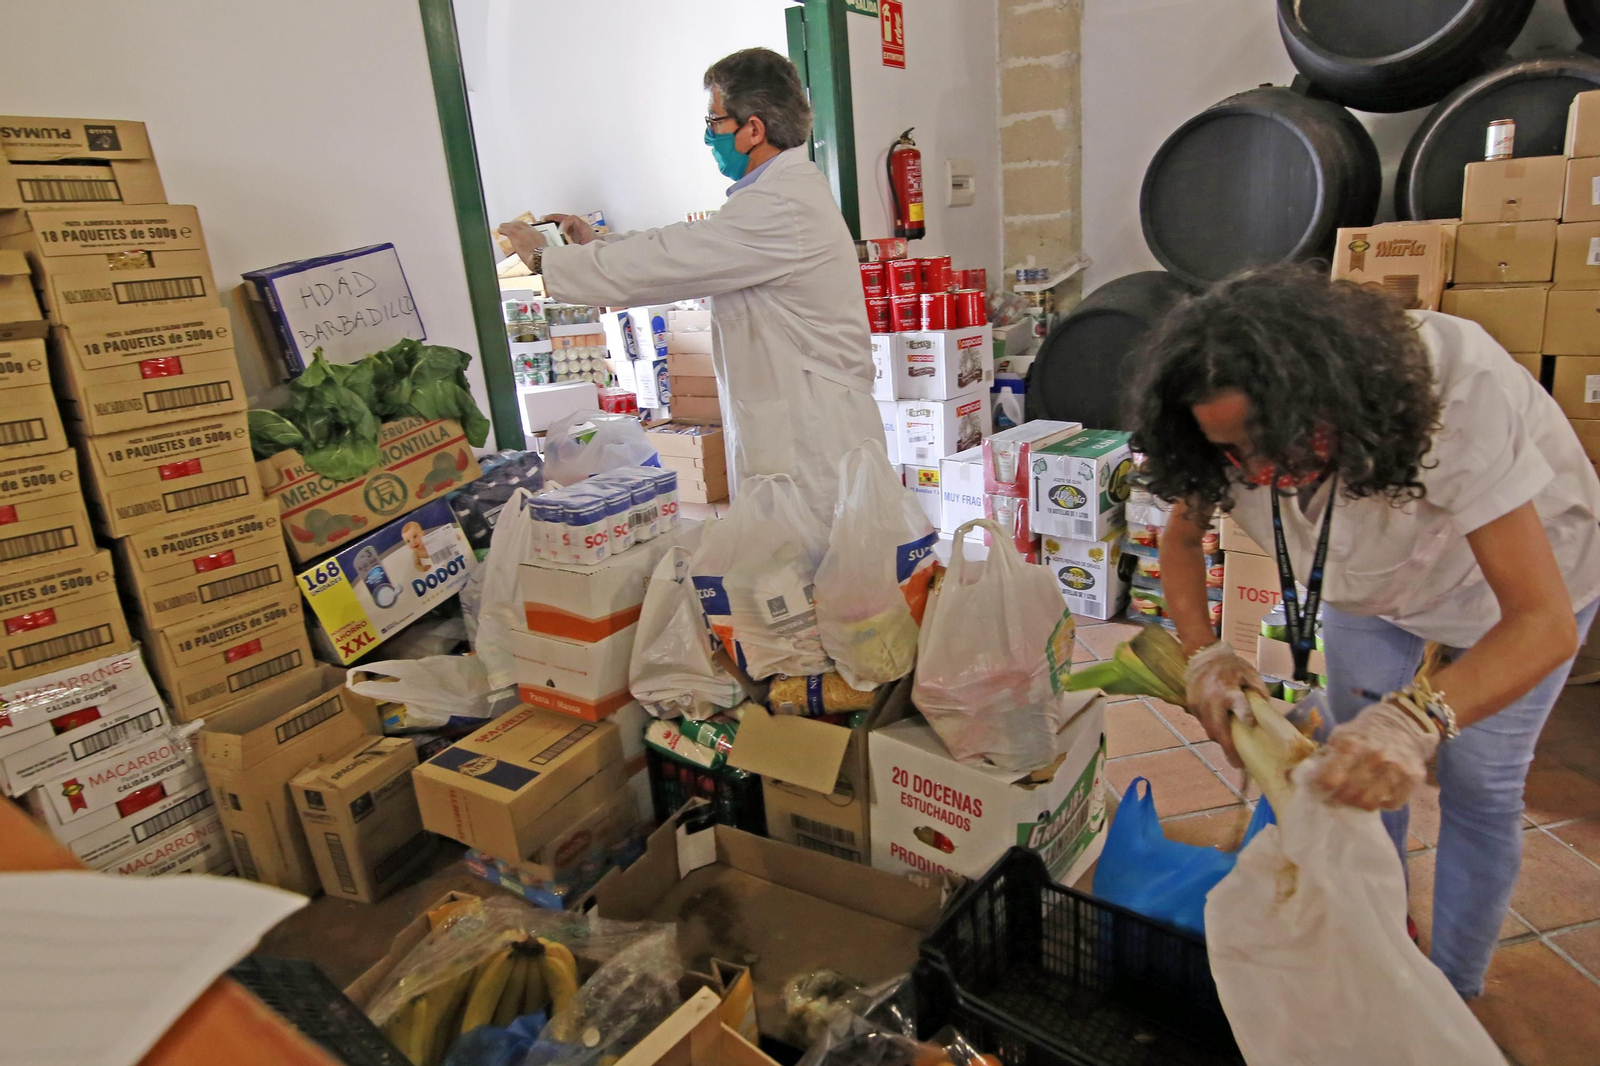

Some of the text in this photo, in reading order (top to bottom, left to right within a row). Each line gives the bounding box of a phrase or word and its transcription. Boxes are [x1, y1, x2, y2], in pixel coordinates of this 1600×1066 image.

[1, 126, 71, 139] PLUMAS
[41, 230, 58, 242] 18
[62, 229, 127, 241] PAQUETES
[130, 228, 145, 239] de
[149, 227, 177, 239] 500g
[84, 344, 100, 355] 18
[103, 335, 165, 353] PAQUETES
[168, 333, 183, 343] de
[185, 329, 214, 340] 500g
[381, 417, 424, 440] FRUTAS
[108, 450, 123, 462] 18
[126, 439, 186, 459] PAQUETES
[189, 436, 202, 447] de
[204, 431, 232, 443] 500g
[2, 479, 18, 492] de
[23, 473, 56, 487] 500g
[944, 492, 982, 506] MUY FRAG
[144, 547, 159, 558] 18
[161, 532, 218, 554] PAQUETES
[222, 528, 235, 539] de
[237, 522, 263, 534] 500g
[40, 584, 57, 596] de
[61, 575, 93, 591] 500g
[302, 561, 341, 590] 168
[311, 576, 342, 597] UNIDADES
[411, 554, 466, 598] DODOT
[178, 641, 193, 652] 18
[194, 621, 247, 647] PAQUETES
[250, 617, 262, 628] de
[263, 608, 287, 622] 500g
[335, 620, 367, 643] AHORRO
[339, 631, 376, 658] XXL
[45, 684, 117, 713] CALIDAD SUPERIOR
[529, 690, 581, 714] Pasta Massa
[475, 709, 533, 742] SPAGHETTI
[117, 775, 150, 793] CALIDAD
[152, 759, 186, 778] SUPERIOR
[892, 766, 983, 818] 20 DOCENAS
[900, 791, 971, 832] ESTUCHADOS
[118, 819, 222, 876] MACARRONES
